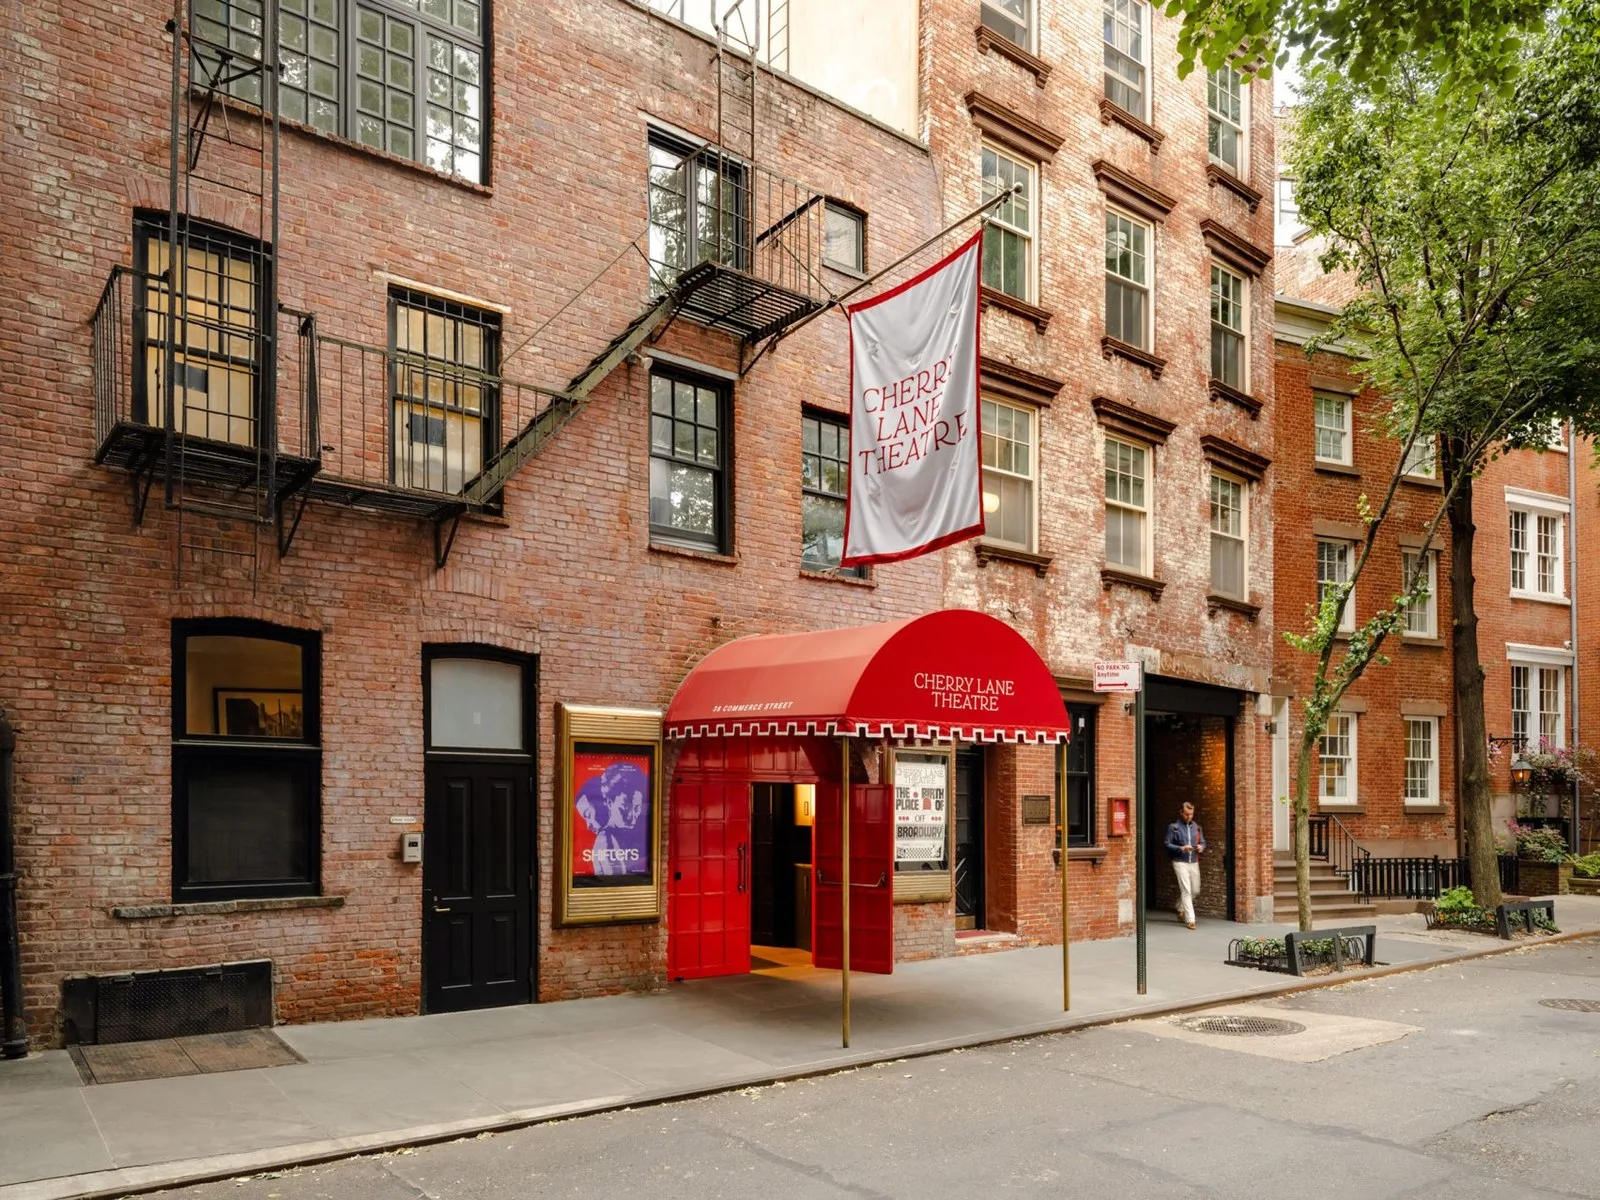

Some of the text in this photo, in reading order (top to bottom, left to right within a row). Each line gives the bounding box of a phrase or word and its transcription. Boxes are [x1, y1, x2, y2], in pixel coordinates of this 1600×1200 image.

[877, 391, 943, 441] LANE
[859, 410, 967, 475] THEATRE
[914, 672, 1015, 696] CHERRY LANE
[722, 703, 763, 712] COMMERCE
[763, 701, 794, 710] STREET
[931, 691, 999, 711] THEATRE
[896, 787, 910, 798] THE
[896, 799, 944, 811] PLACE OF
